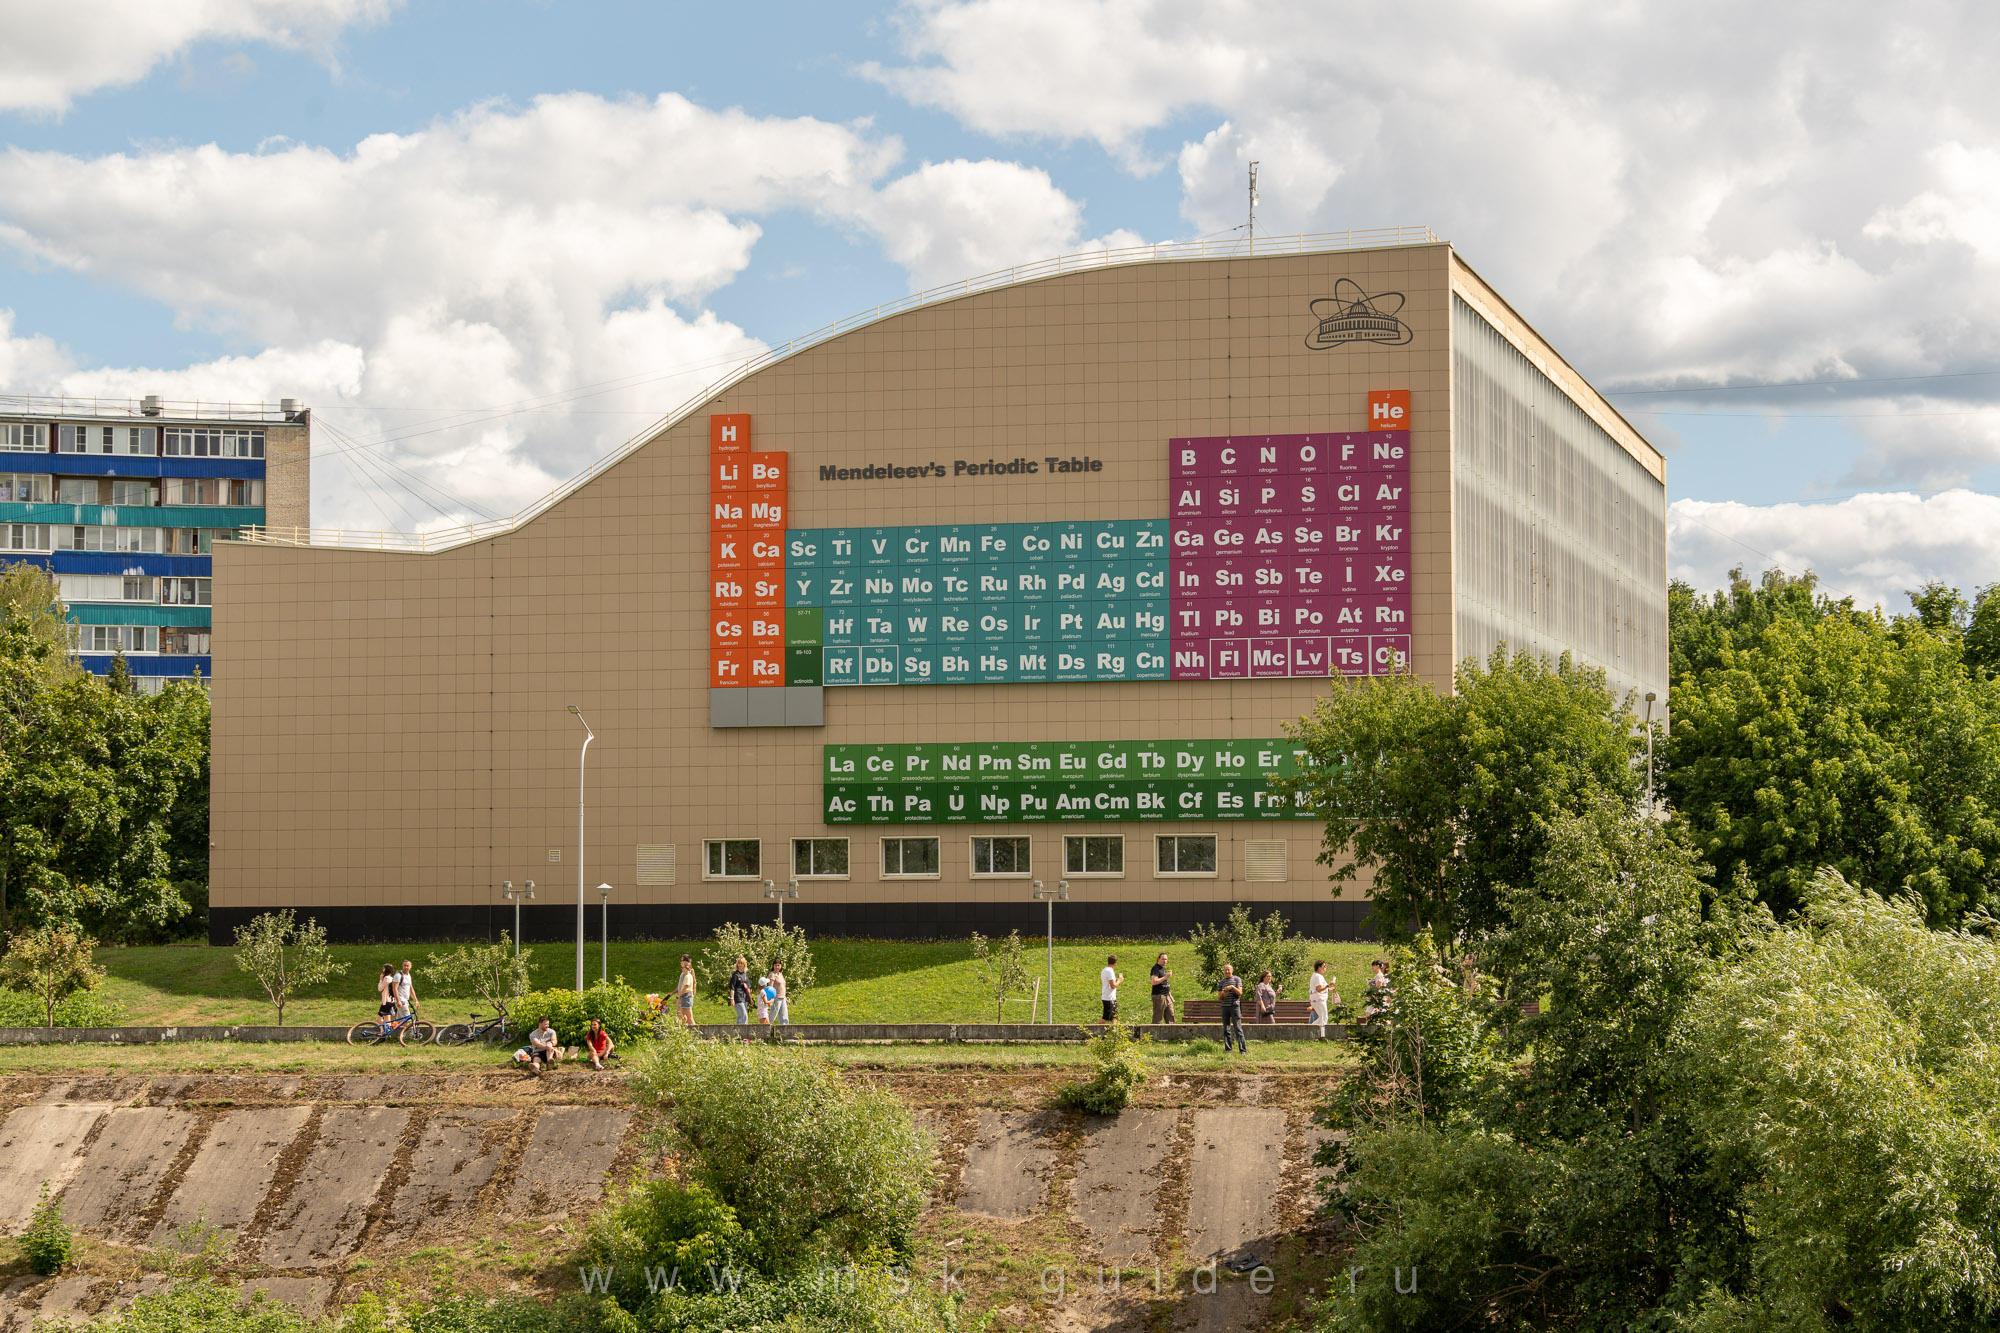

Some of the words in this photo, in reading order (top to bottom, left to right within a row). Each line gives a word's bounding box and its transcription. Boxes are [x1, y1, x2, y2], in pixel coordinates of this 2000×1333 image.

[1373, 403, 1404, 419] He
[722, 426, 736, 442] H
[1181, 450, 1196, 466] B
[1221, 448, 1236, 464] C
[1260, 447, 1276, 463] N
[1300, 446, 1316, 462] O
[1342, 444, 1355, 461] F
[1374, 443, 1404, 459] Ne
[720, 464, 738, 481] Li
[753, 464, 780, 479] Be
[819, 462, 946, 481] Mendeleev's
[953, 458, 1039, 477] Periodic
[1045, 456, 1103, 474] Table
[1178, 490, 1200, 506] Al
[1219, 489, 1239, 505] Si
[1262, 488, 1275, 504] P
[1301, 486, 1316, 503] S
[1338, 485, 1360, 501] Cl
[1376, 484, 1402, 500] Ar
[715, 504, 743, 519] Na
[751, 503, 781, 522] Mg
[1096, 532, 1124, 549] Cu
[1136, 531, 1163, 548] Zn
[1174, 530, 1204, 547] Ga
[1214, 529, 1244, 545] Ge
[1254, 528, 1283, 544] As
[1295, 527, 1323, 543] Se
[1336, 526, 1361, 542] Br
[1376, 524, 1403, 541] Kr
[791, 541, 817, 557] Sc
[832, 540, 851, 555] Ti
[872, 539, 887, 554] V
[905, 538, 929, 554] Cr
[940, 537, 971, 553] Mn
[981, 536, 1006, 551] Fe
[1022, 535, 1050, 551] Co
[1061, 533, 1082, 549] Ni
[721, 543, 736, 559] K
[752, 542, 780, 558] Ca
[1058, 573, 1085, 590] Pd
[1136, 571, 1164, 588] Cd
[1179, 571, 1199, 587] In
[1215, 569, 1243, 586] Sn
[1255, 568, 1283, 585] Sb
[1295, 568, 1322, 584] Te
[1375, 565, 1405, 582] Xe
[716, 582, 742, 598] Rb
[755, 581, 778, 597] Sr
[796, 580, 811, 595] Y
[830, 579, 853, 595] Zr
[865, 578, 893, 594] Nb
[902, 577, 933, 593] Mo
[943, 576, 968, 592] Tc
[981, 576, 1008, 591] Ru
[1019, 574, 1046, 590] Rh
[1096, 573, 1125, 592] Ag
[1025, 615, 1041, 630] Ir
[1060, 614, 1083, 630] Pt
[1097, 613, 1125, 629] Au
[1136, 612, 1164, 632] Hg
[1179, 610, 1200, 627] Tl
[1216, 610, 1243, 626] Pb
[1259, 609, 1280, 625] Bi
[1295, 608, 1323, 624] Po
[1337, 607, 1363, 623] At
[1376, 606, 1404, 623] Rn
[716, 621, 742, 637] Cs
[752, 620, 779, 636] Ba
[830, 618, 854, 634] Hf
[867, 618, 892, 634] Ta
[907, 617, 927, 633] W
[942, 616, 969, 632] Re
[980, 615, 1008, 631] Os
[942, 656, 969, 672] Bh
[980, 655, 1008, 671] Hs
[1020, 654, 1046, 670] Mt
[1058, 654, 1085, 670] Ds
[1097, 653, 1125, 673] Rg
[1136, 652, 1164, 669] Cn
[1175, 651, 1204, 668] Nh
[1220, 650, 1239, 667] Fl
[1253, 650, 1285, 666] Mc
[1296, 649, 1322, 665] Lv
[1337, 648, 1363, 664] Ts
[718, 660, 739, 676] Fr
[753, 659, 779, 675] Ra
[830, 658, 853, 674] Rf
[866, 657, 893, 673] Db
[904, 656, 931, 677] Sg
[830, 756, 855, 772] La
[866, 756, 894, 772] Ce
[907, 755, 930, 771] Pr
[943, 755, 971, 771] Nd
[979, 755, 1012, 770] Pm
[1017, 754, 1051, 770] Sm
[1060, 753, 1086, 769] Eu
[1097, 753, 1127, 769] Gd
[1137, 752, 1165, 768] Tb
[1177, 752, 1204, 772] Dy
[1216, 751, 1245, 767] Ho
[1258, 751, 1282, 767] Er
[828, 796, 856, 812] Ac
[867, 796, 894, 811] Th
[905, 795, 931, 811] Pa
[949, 795, 964, 811] U
[981, 794, 1010, 814] Np
[1021, 794, 1047, 810] Pu
[1056, 793, 1090, 810] Am
[1095, 793, 1129, 809] Cm
[1137, 792, 1165, 809] Bk
[1179, 792, 1203, 809] Cf
[1218, 792, 1244, 808] Es
